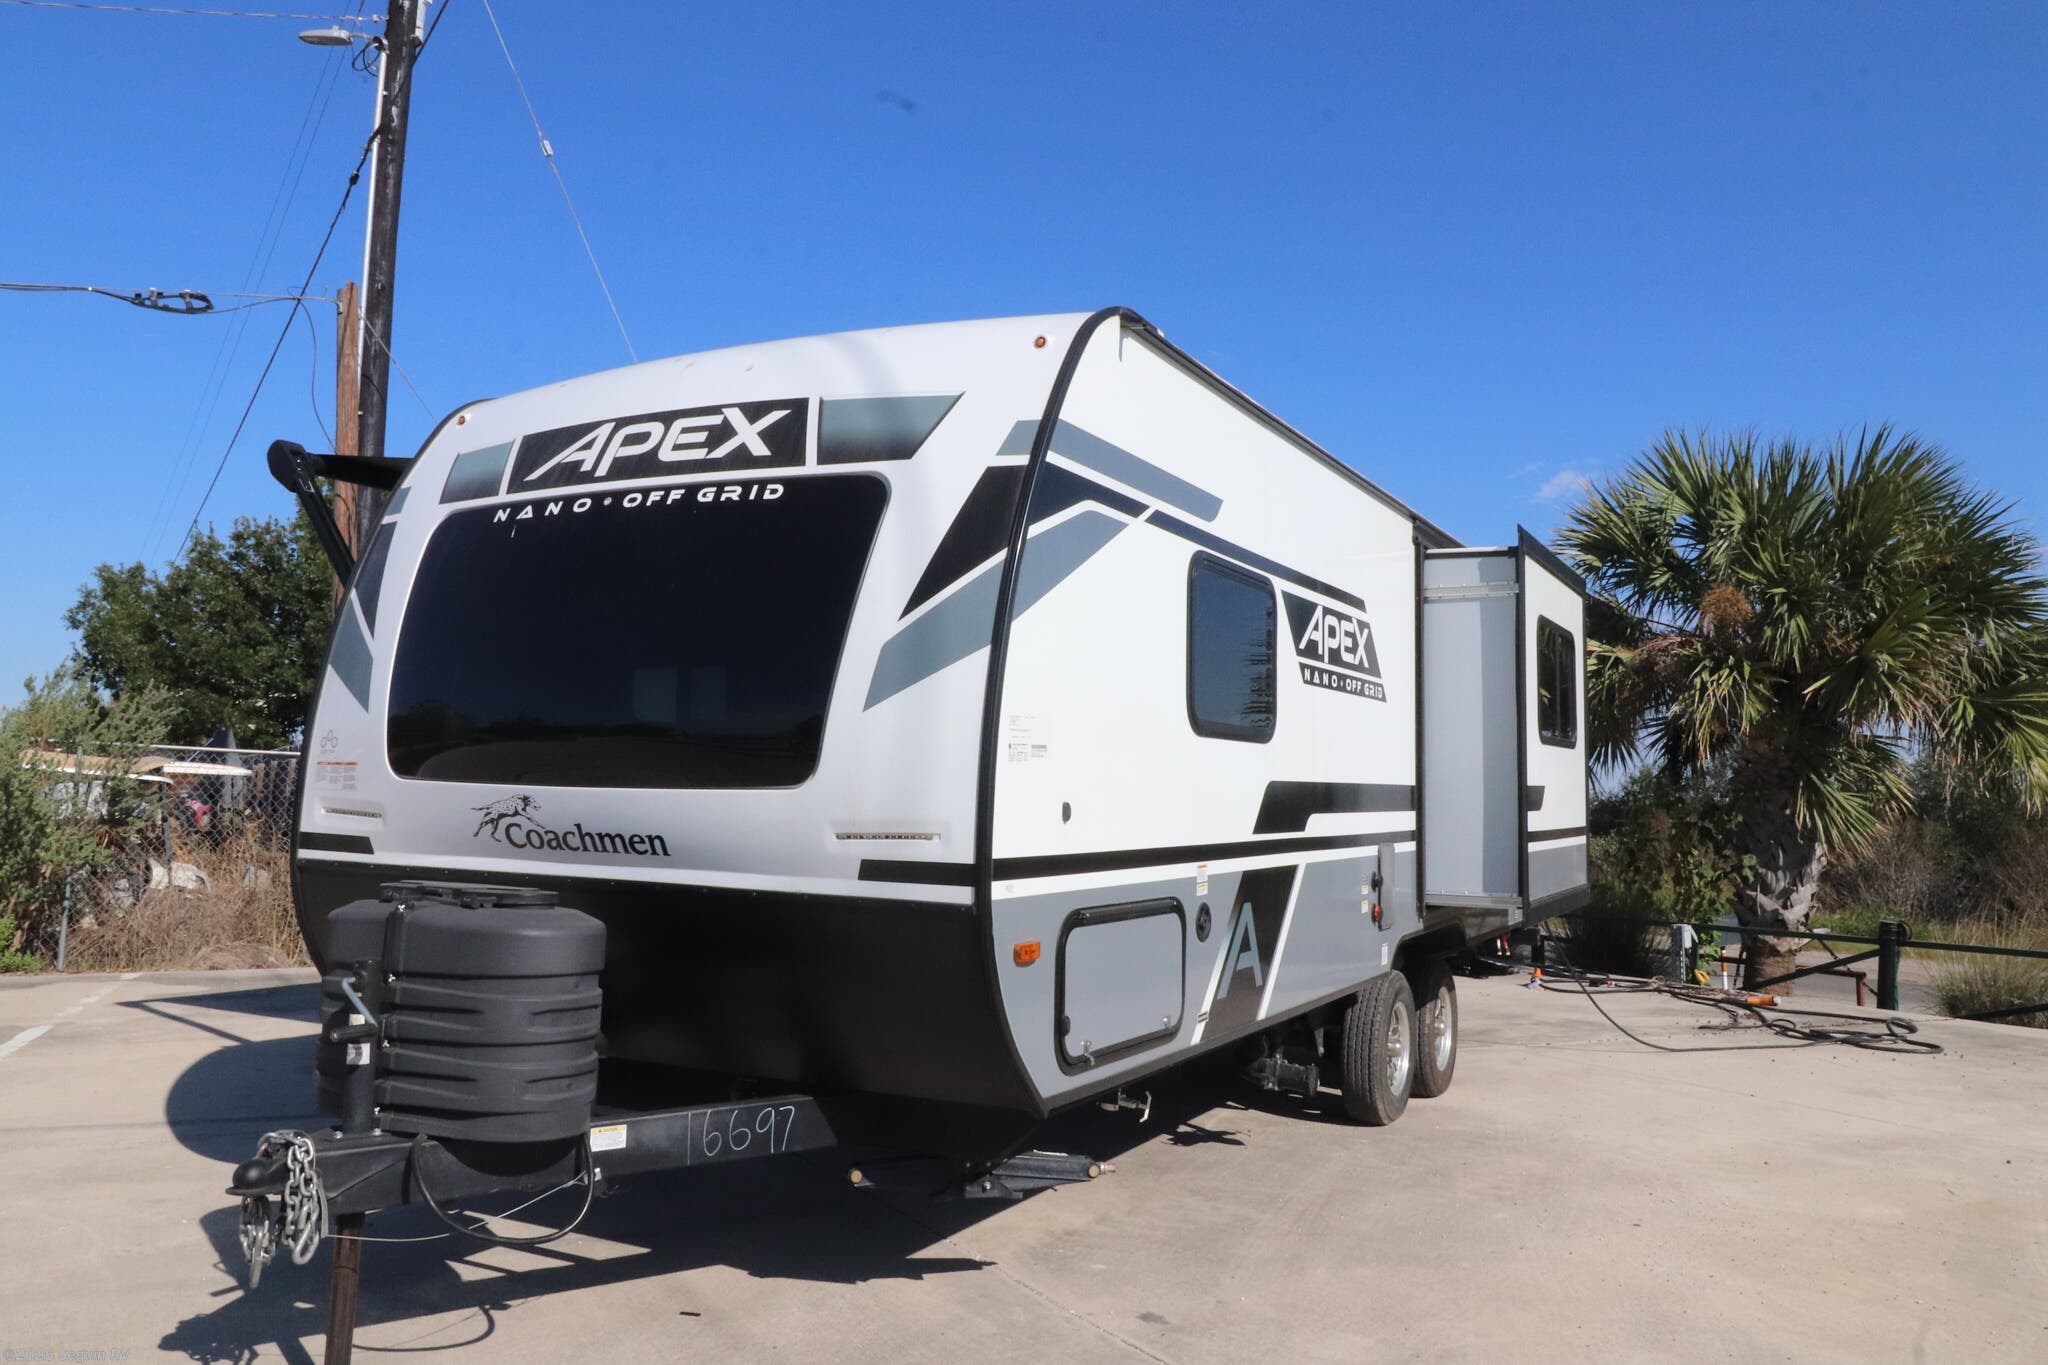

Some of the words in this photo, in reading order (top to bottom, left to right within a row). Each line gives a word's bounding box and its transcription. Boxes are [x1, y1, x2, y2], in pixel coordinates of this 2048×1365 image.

[523, 407, 792, 481] APEX
[493, 498, 592, 523] NANO
[622, 489, 686, 508] OFF
[696, 483, 784, 503] GRID
[1298, 604, 1369, 669] APEX
[1304, 668, 1338, 688] NANO
[1345, 678, 1362, 693] OFF
[1364, 683, 1383, 698] GRID
[504, 823, 672, 857] Coachmen
[686, 1105, 796, 1166] 16697
